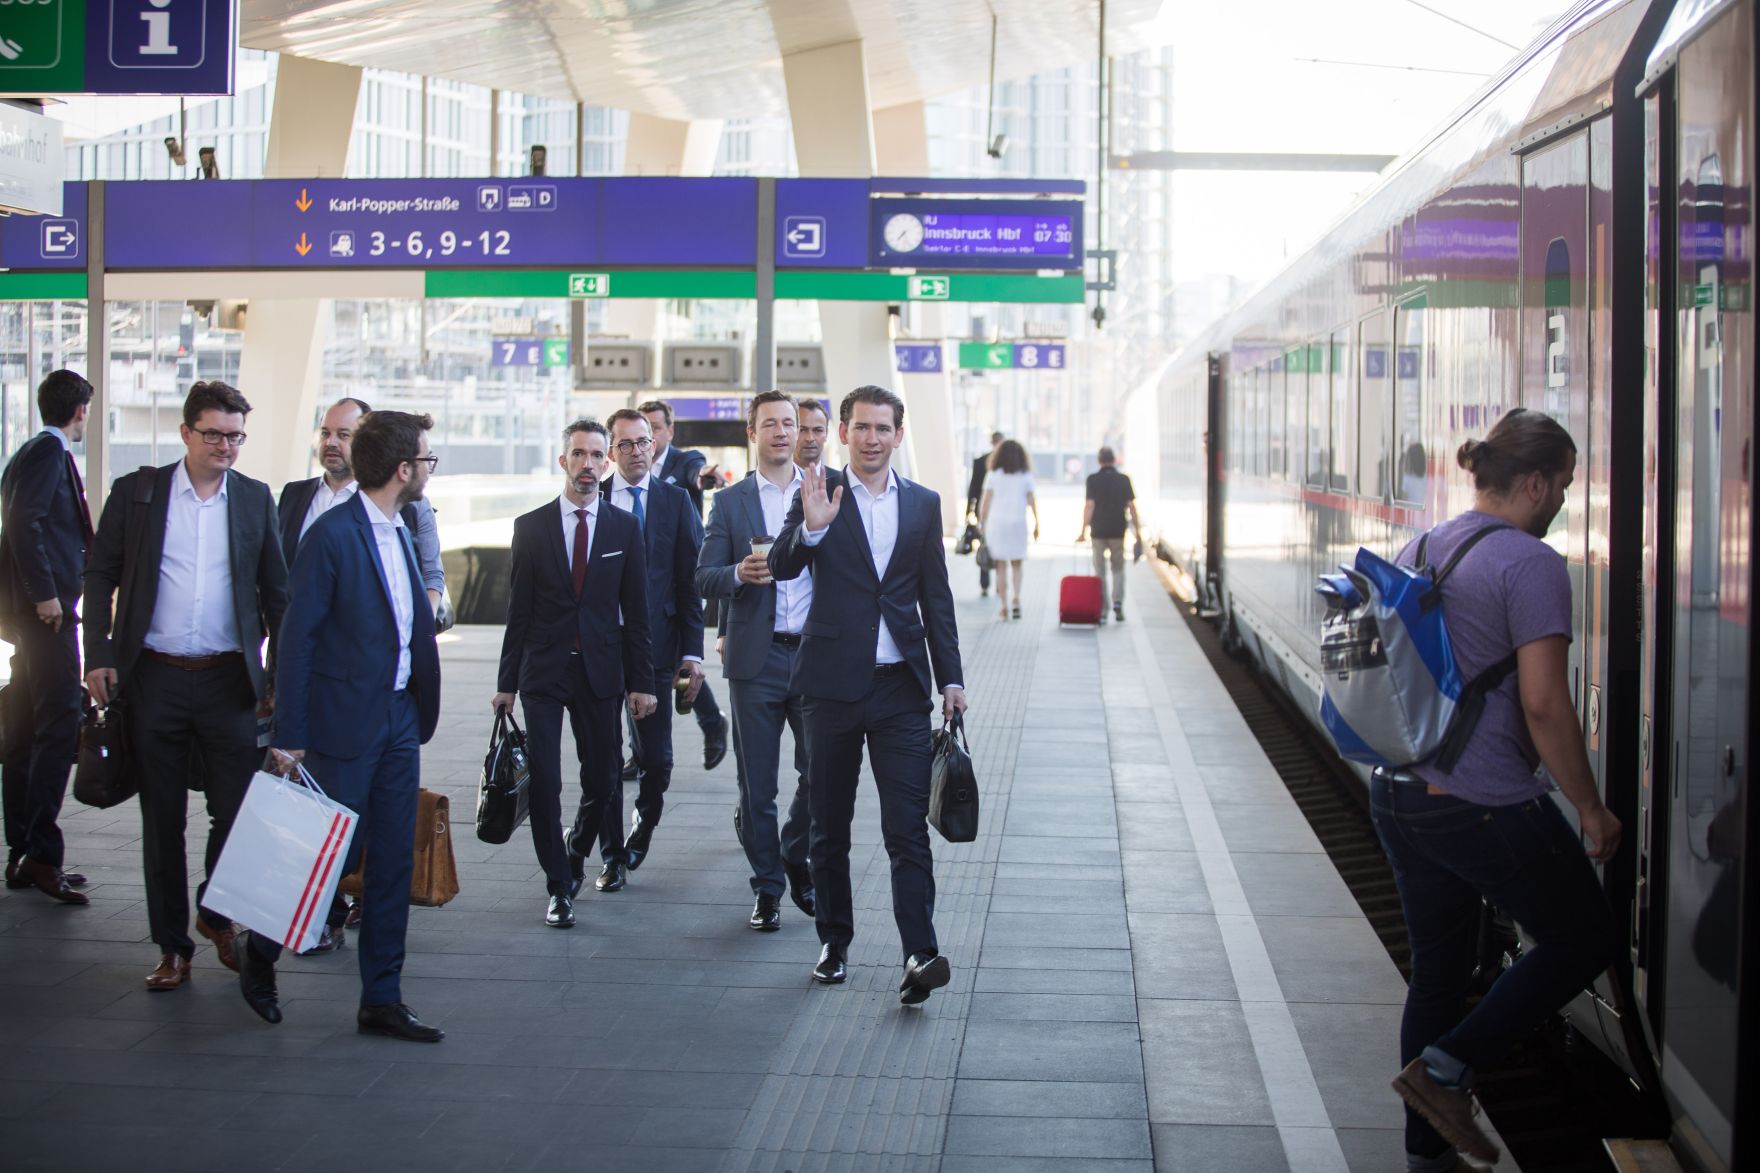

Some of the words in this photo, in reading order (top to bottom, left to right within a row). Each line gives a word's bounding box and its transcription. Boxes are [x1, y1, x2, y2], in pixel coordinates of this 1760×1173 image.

[329, 197, 460, 214] Karl-Popper-Straße
[924, 227, 992, 240] Innsbruck
[997, 228, 1021, 240] Hbf
[502, 343, 517, 364] 7
[528, 347, 540, 364] E
[1020, 345, 1039, 367] 8
[1548, 314, 1566, 387] 2
